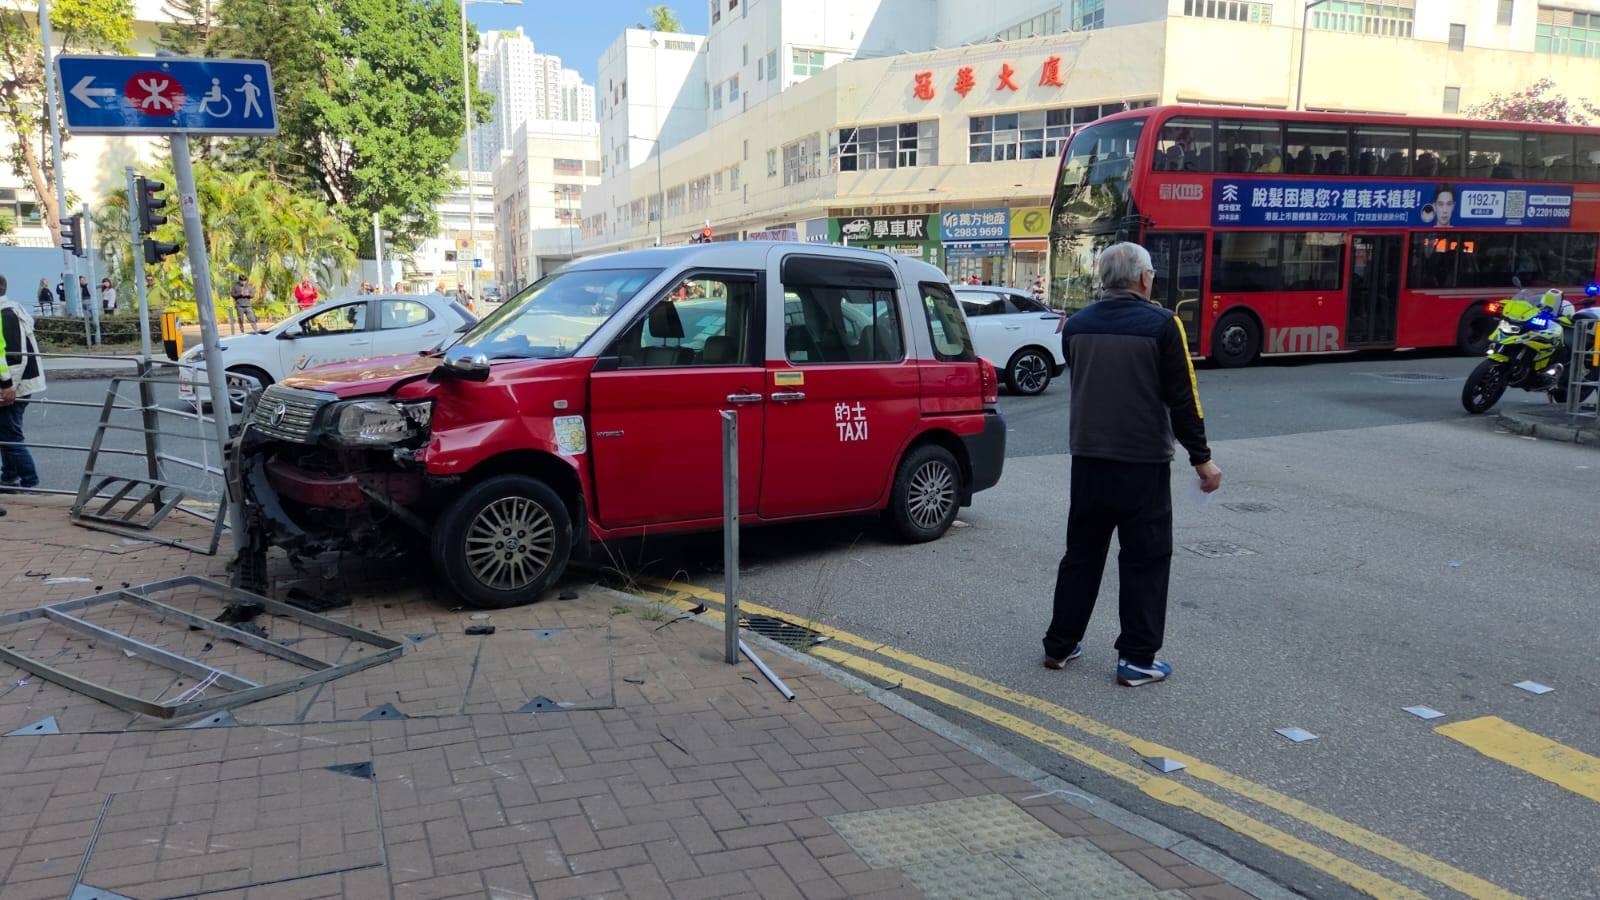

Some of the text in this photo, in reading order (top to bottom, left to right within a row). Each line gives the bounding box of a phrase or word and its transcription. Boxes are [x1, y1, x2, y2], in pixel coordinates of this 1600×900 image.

[913, 56, 1064, 100] 冠華大廈
[1172, 184, 1204, 200] KMB
[954, 226, 1003, 237] 2983 9699
[835, 401, 866, 420] 的士
[836, 421, 868, 441] TAXI
